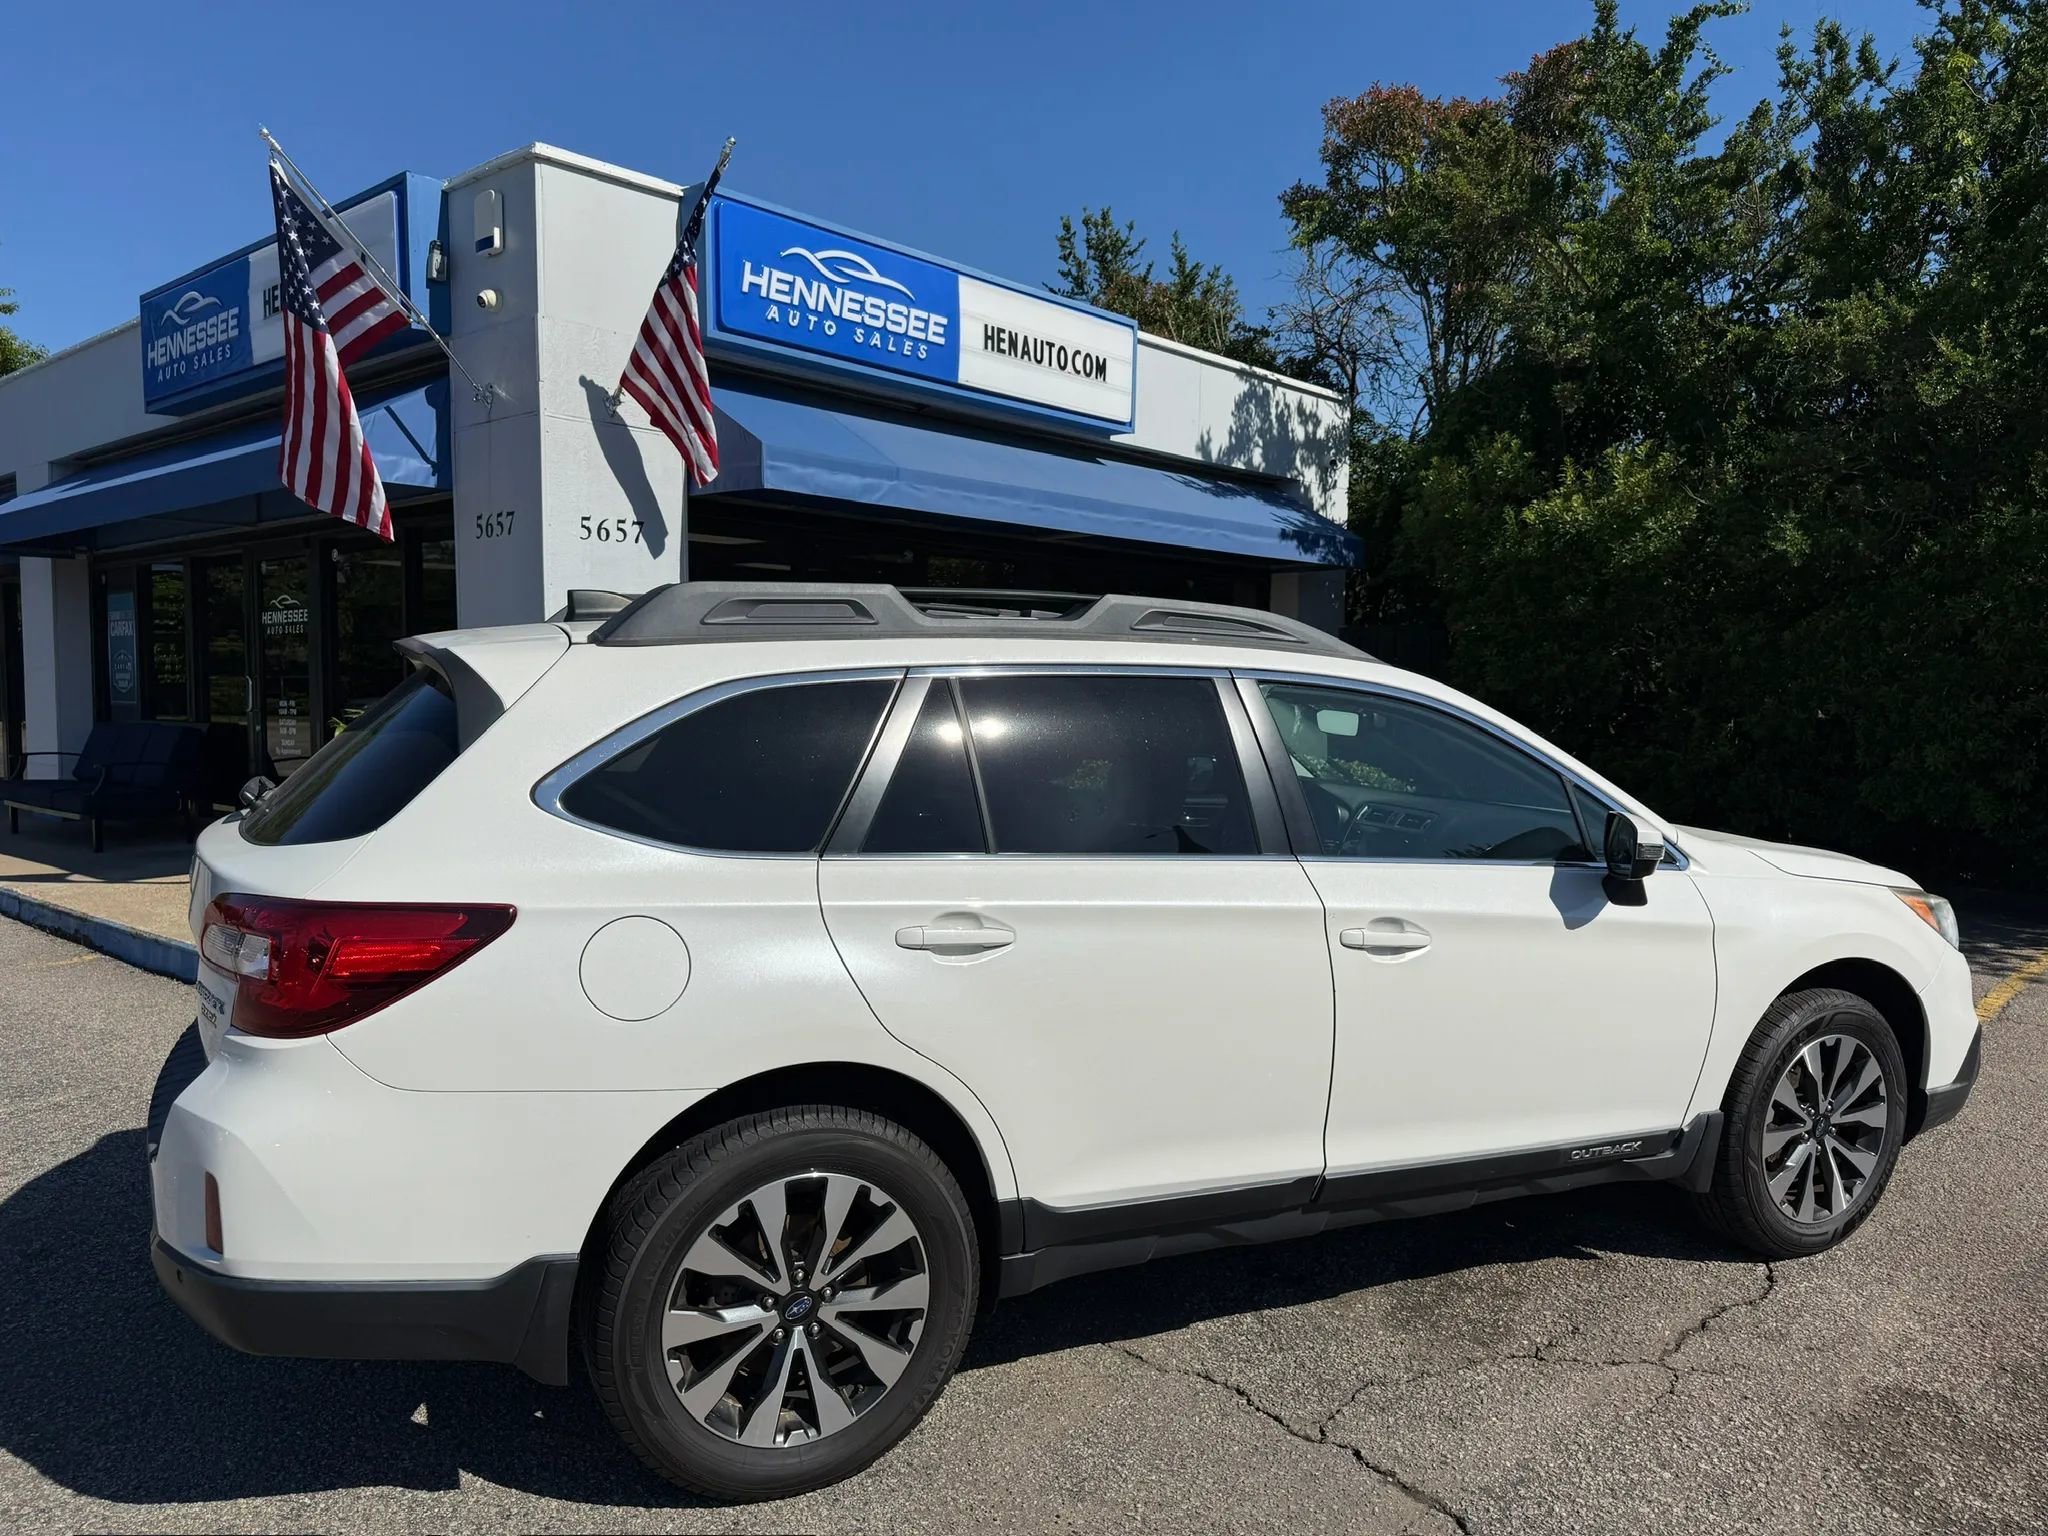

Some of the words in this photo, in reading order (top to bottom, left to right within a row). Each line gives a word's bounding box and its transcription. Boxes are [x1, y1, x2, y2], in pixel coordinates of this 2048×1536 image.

[741, 260, 948, 346] HENNESSEE
[147, 306, 240, 369] HENNESSEE
[764, 303, 837, 337] AUTO
[853, 327, 929, 361] SALES
[157, 361, 187, 383] AUTO
[193, 344, 231, 370] SALES
[983, 323, 1108, 383] HENAUTO.COM
[475, 510, 515, 540] 5657
[579, 514, 645, 544] 5657
[261, 608, 308, 624] HENNESSEE
[266, 625, 283, 635] AUTO
[284, 624, 304, 635] SALES
[1569, 1140, 1643, 1161] OUTBACK
